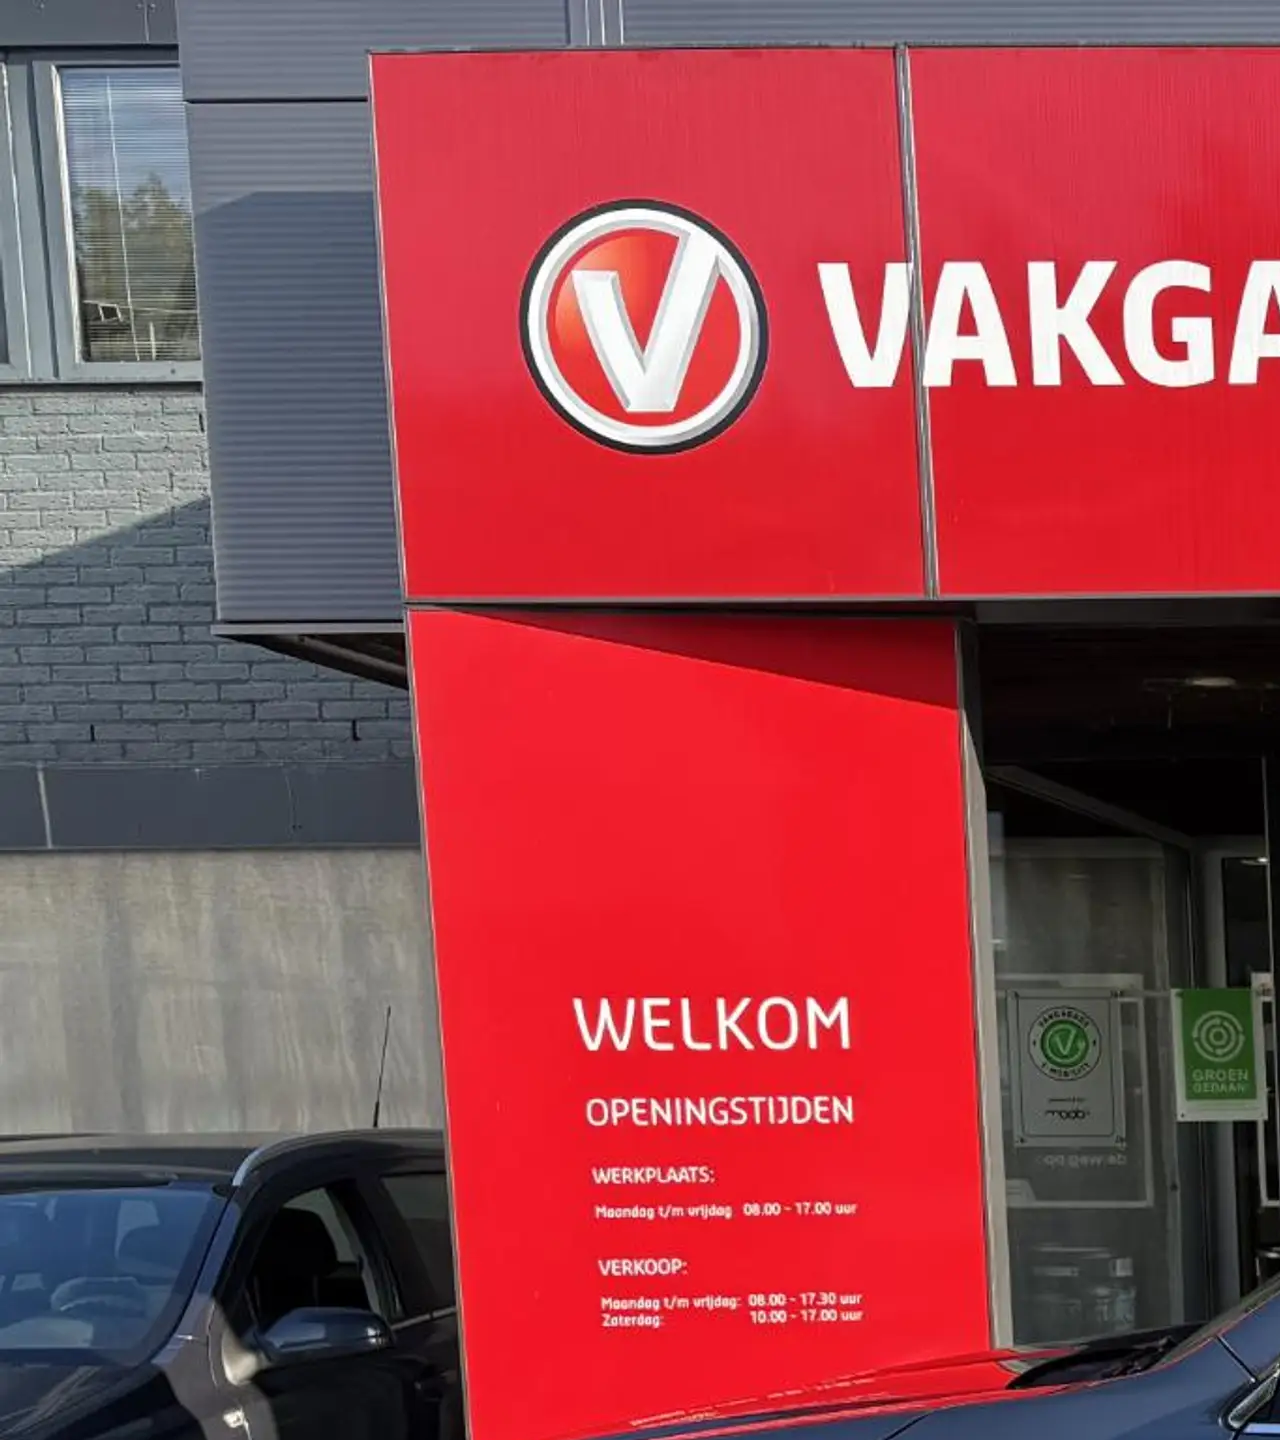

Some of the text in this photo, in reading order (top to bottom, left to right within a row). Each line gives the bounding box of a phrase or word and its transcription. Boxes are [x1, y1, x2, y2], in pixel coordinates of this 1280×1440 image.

[573, 996, 850, 1052] WELKOM
[1192, 1068, 1248, 1081] GROEN
[586, 1095, 854, 1127] OPENINGSTIJDEN
[591, 1165, 715, 1185] WERKPLAATS:
[595, 1205, 655, 1221] Maandag
[658, 1205, 685, 1219] t/m
[687, 1204, 733, 1220] vrijdag
[742, 1202, 782, 1217] 08.00
[795, 1201, 832, 1216] 17.00
[834, 1203, 857, 1215] uur
[597, 1257, 688, 1277] VERKOOP:
[600, 1296, 661, 1312] Maandag
[663, 1296, 690, 1310] t/m
[692, 1295, 741, 1311] vrijdag:
[748, 1293, 787, 1307] 08.00
[799, 1291, 837, 1306] 17.30
[839, 1294, 862, 1305] uur
[602, 1314, 663, 1329] Zaterdag:
[749, 1309, 788, 1324] 10.00
[800, 1308, 838, 1322] 17.00
[840, 1311, 863, 1321] uur
